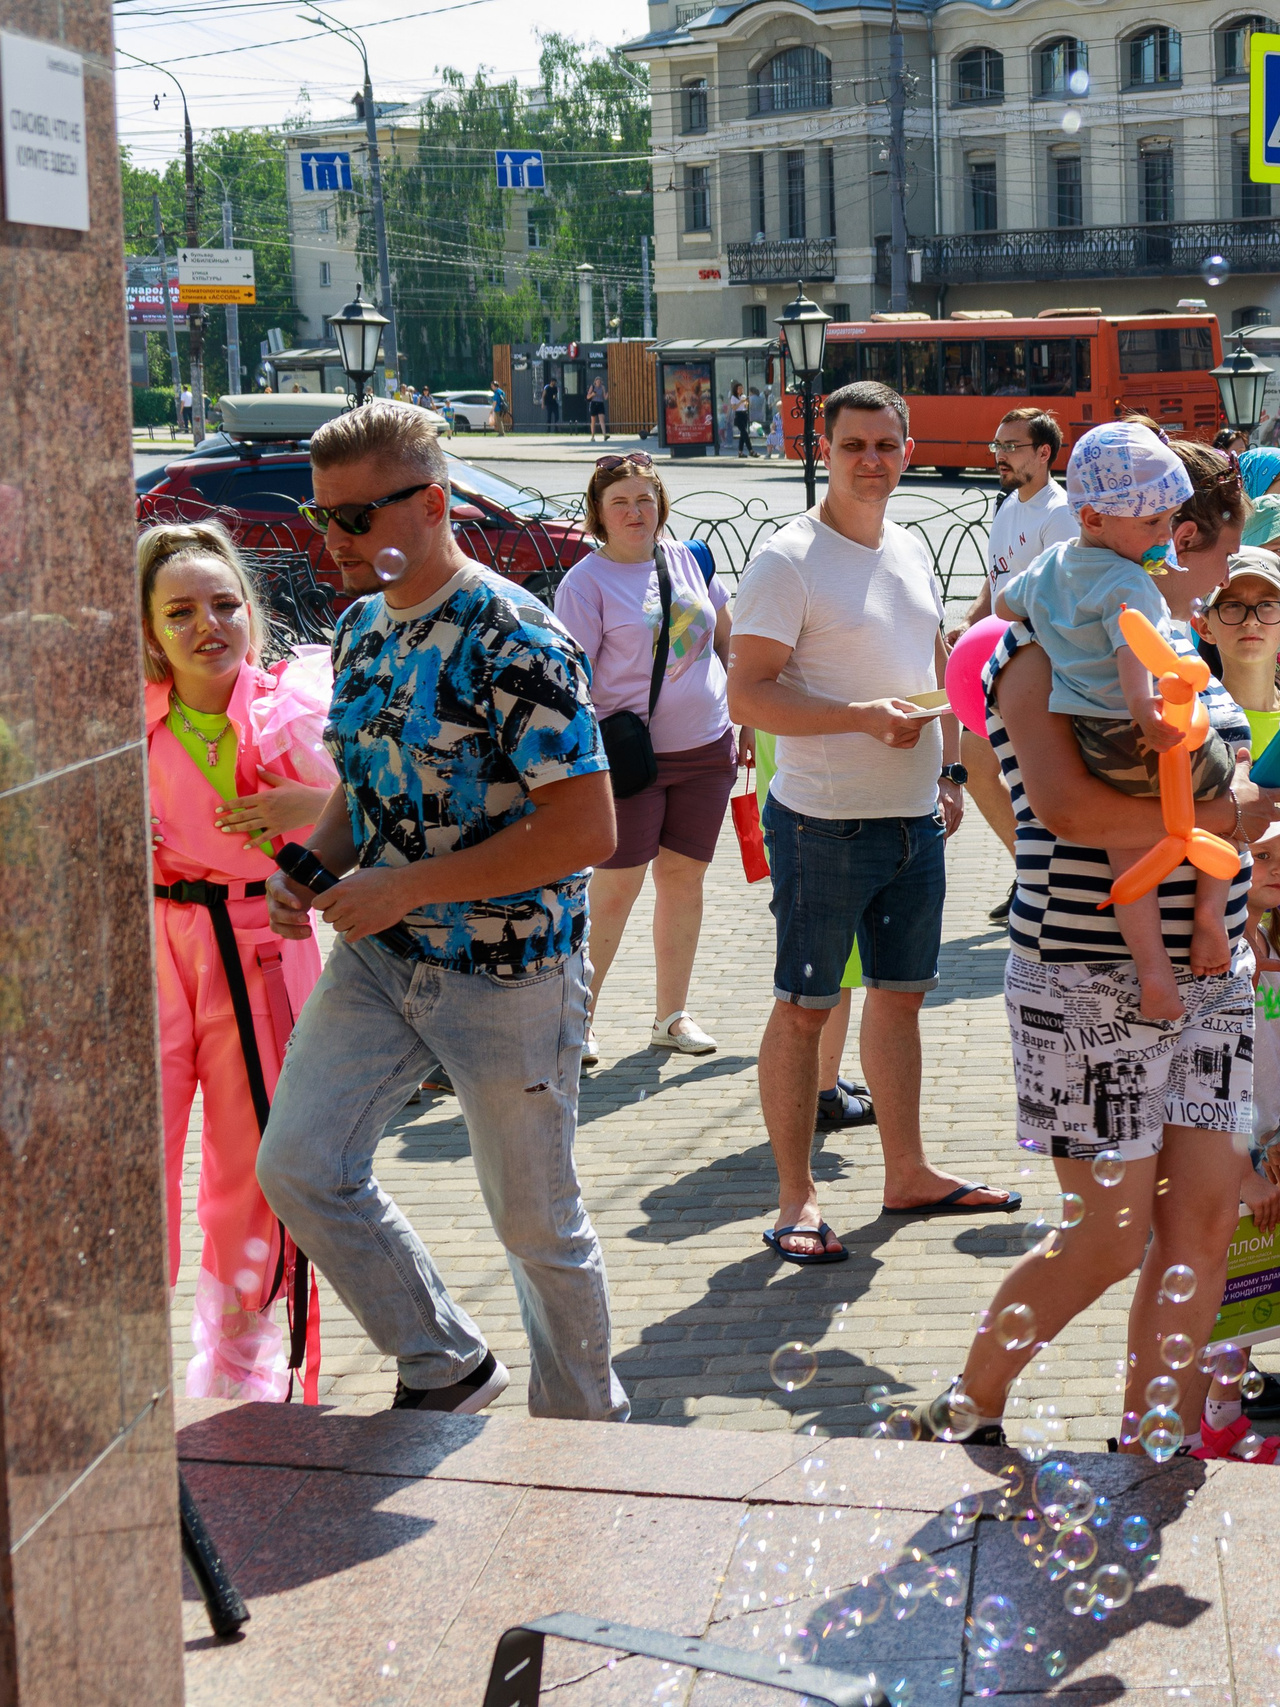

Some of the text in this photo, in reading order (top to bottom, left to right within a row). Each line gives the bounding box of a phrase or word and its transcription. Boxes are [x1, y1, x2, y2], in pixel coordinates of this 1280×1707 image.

[698, 269, 721, 280] SPA
[1201, 1017, 1243, 1034] EXTR
[1021, 1030, 1057, 1050] Paper
[1079, 1020, 1132, 1051] NEW
[1127, 1040, 1170, 1063] EXTRA
[1227, 1233, 1275, 1258] ПЛОМ
[1228, 1277, 1260, 1292] САМОМУ
[1230, 1283, 1273, 1300] КОНДИТЕРУ
